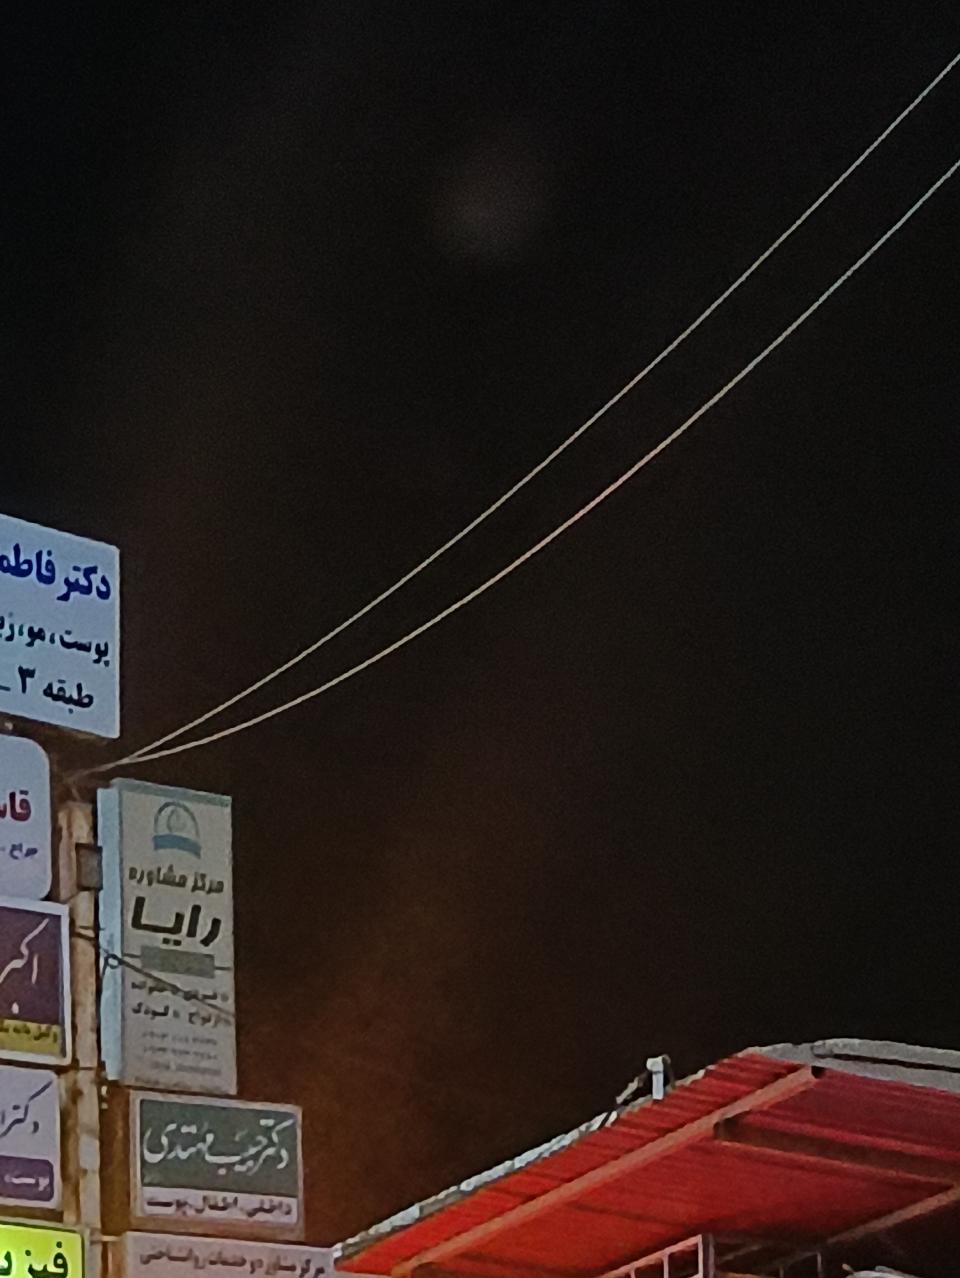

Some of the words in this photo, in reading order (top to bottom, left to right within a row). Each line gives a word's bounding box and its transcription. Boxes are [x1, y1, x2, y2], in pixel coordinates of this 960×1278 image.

[56, 565, 111, 601] دکتر
[18, 666, 36, 694] ۳
[42, 679, 94, 714] طبقه
[128, 864, 188, 888] مشاوره
[191, 872, 224, 895] مرکز
[131, 896, 222, 947] رایا
[0, 1080, 54, 1138] دکتر
